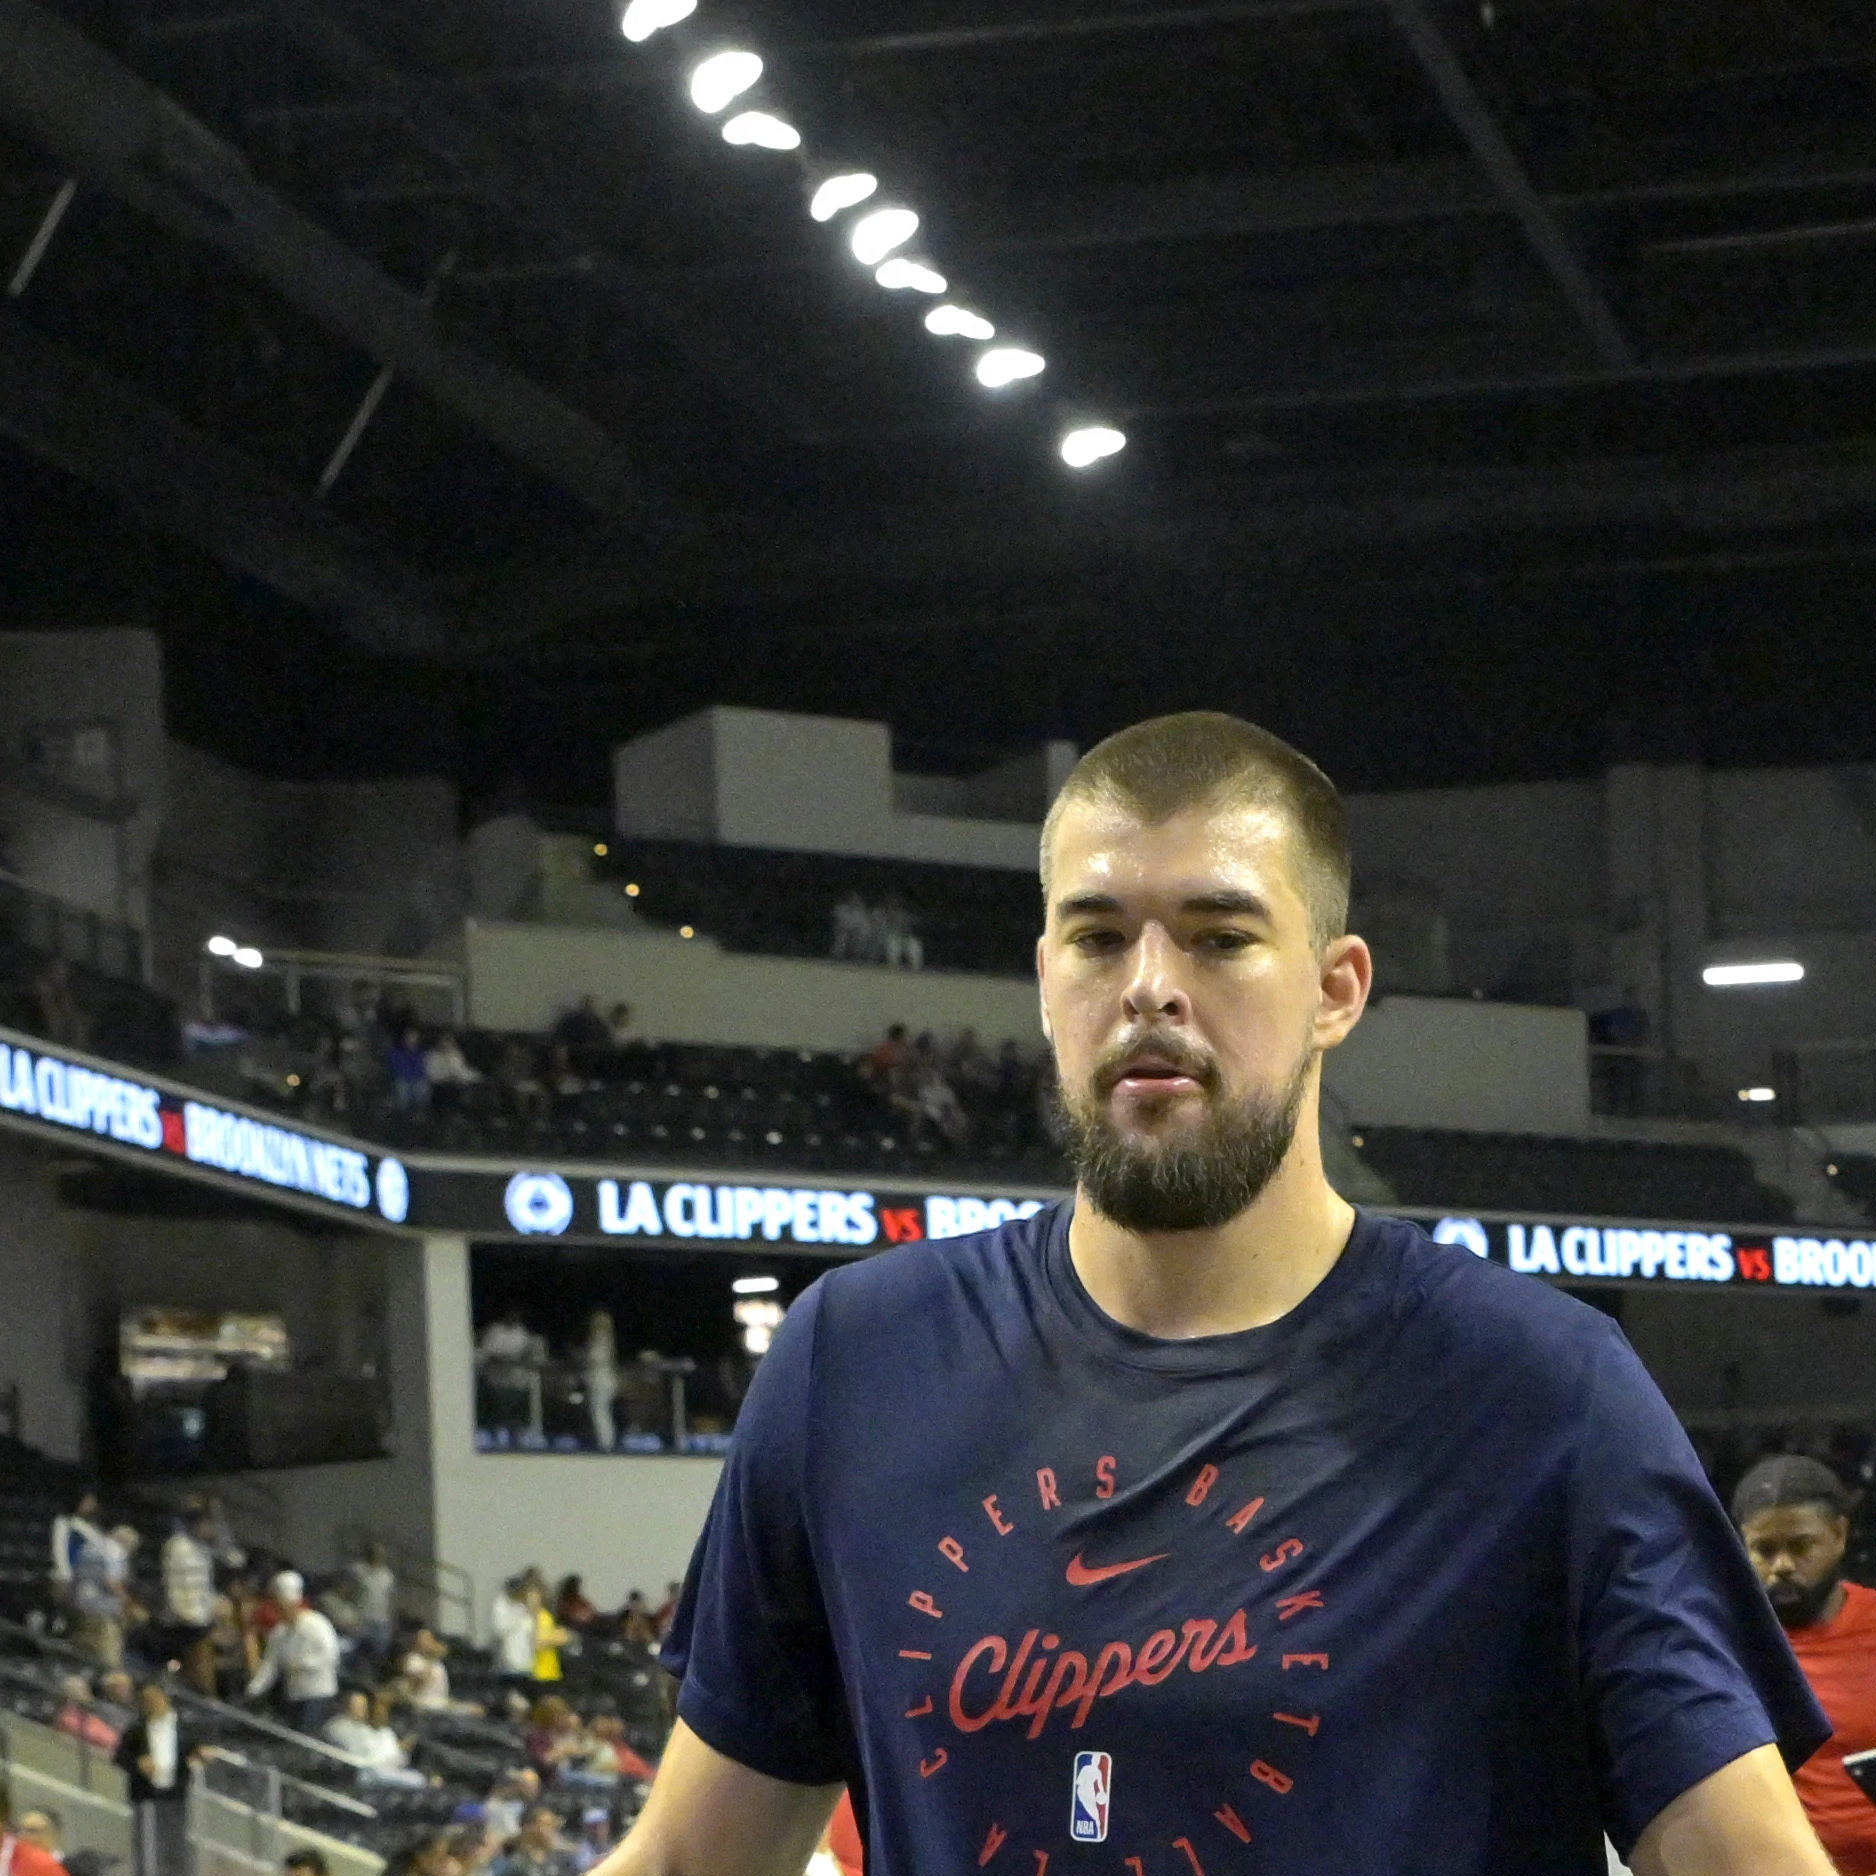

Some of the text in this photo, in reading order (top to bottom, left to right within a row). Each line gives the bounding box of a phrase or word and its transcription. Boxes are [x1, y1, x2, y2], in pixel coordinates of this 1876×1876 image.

[36, 1056, 163, 1150] CLIPPERS
[597, 1179, 664, 1236] LA
[663, 1182, 879, 1245] CLIPPERS
[1507, 1223, 1561, 1275] LA
[1561, 1227, 1737, 1284] CLIPPERS
[899, 1455, 1117, 1779] CLIPPERS
[948, 1607, 1258, 1740] Clippers
[1075, 1819, 1096, 1836] NBA
